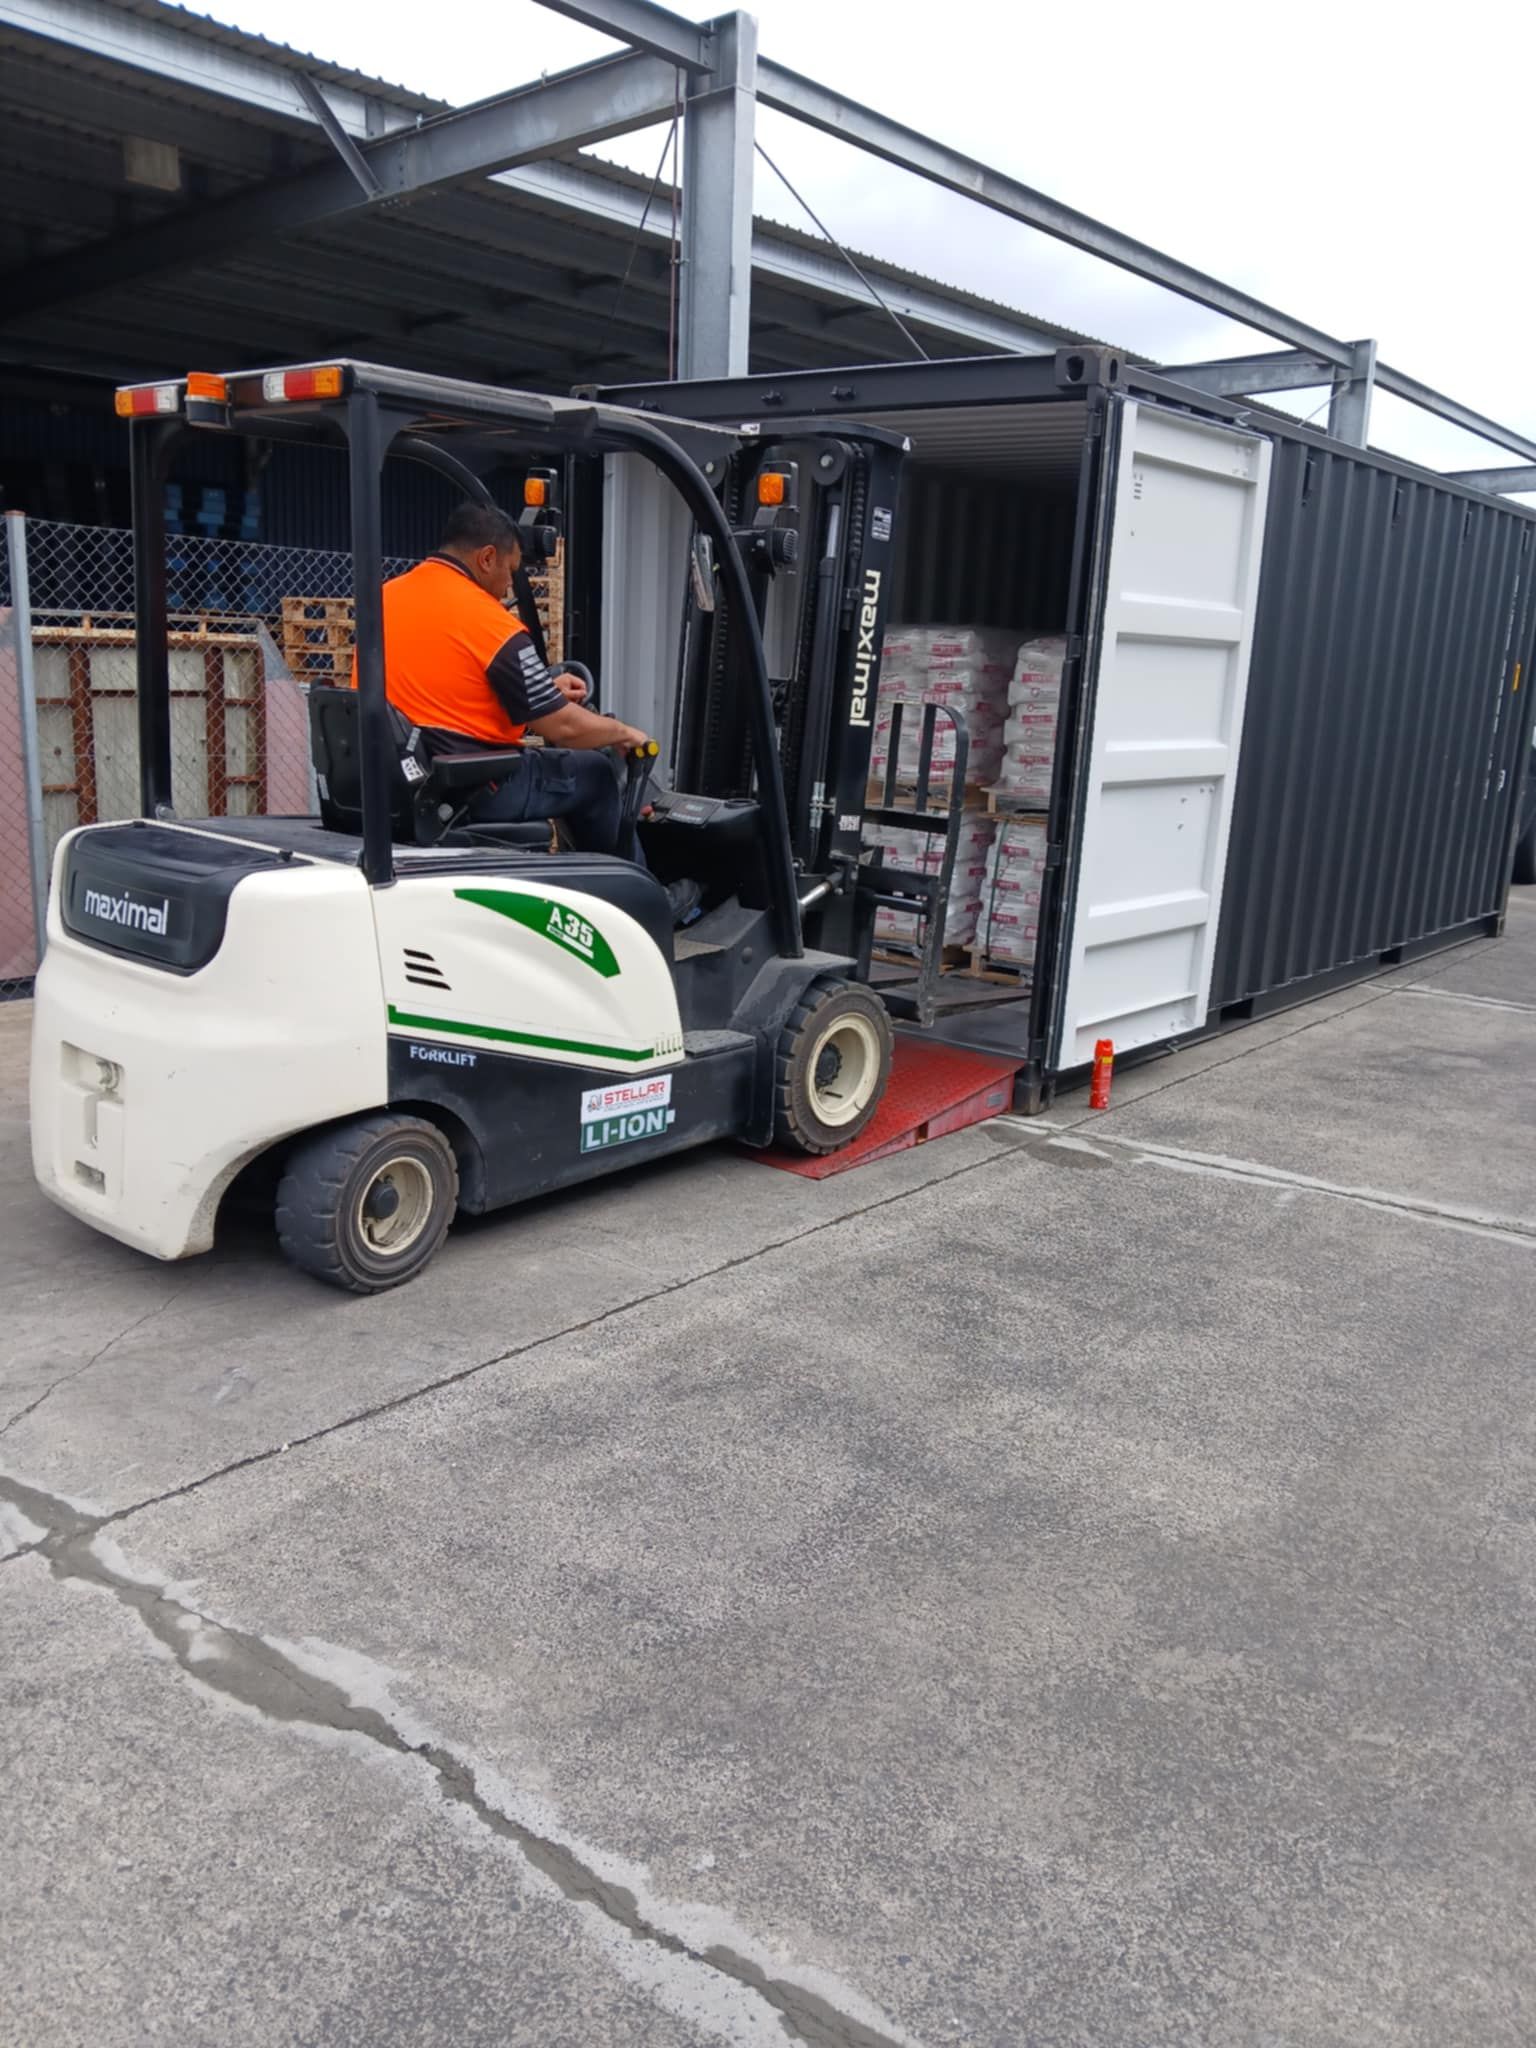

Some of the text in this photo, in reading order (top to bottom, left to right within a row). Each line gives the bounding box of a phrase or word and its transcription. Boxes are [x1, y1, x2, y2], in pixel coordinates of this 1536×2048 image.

[849, 569, 881, 727] maximal
[85, 889, 169, 935] maximal
[550, 906, 594, 947] A35
[409, 1045, 476, 1067] FORKLIFT
[604, 1081, 665, 1105] STELLAR
[586, 1108, 664, 1148] LI-ION
